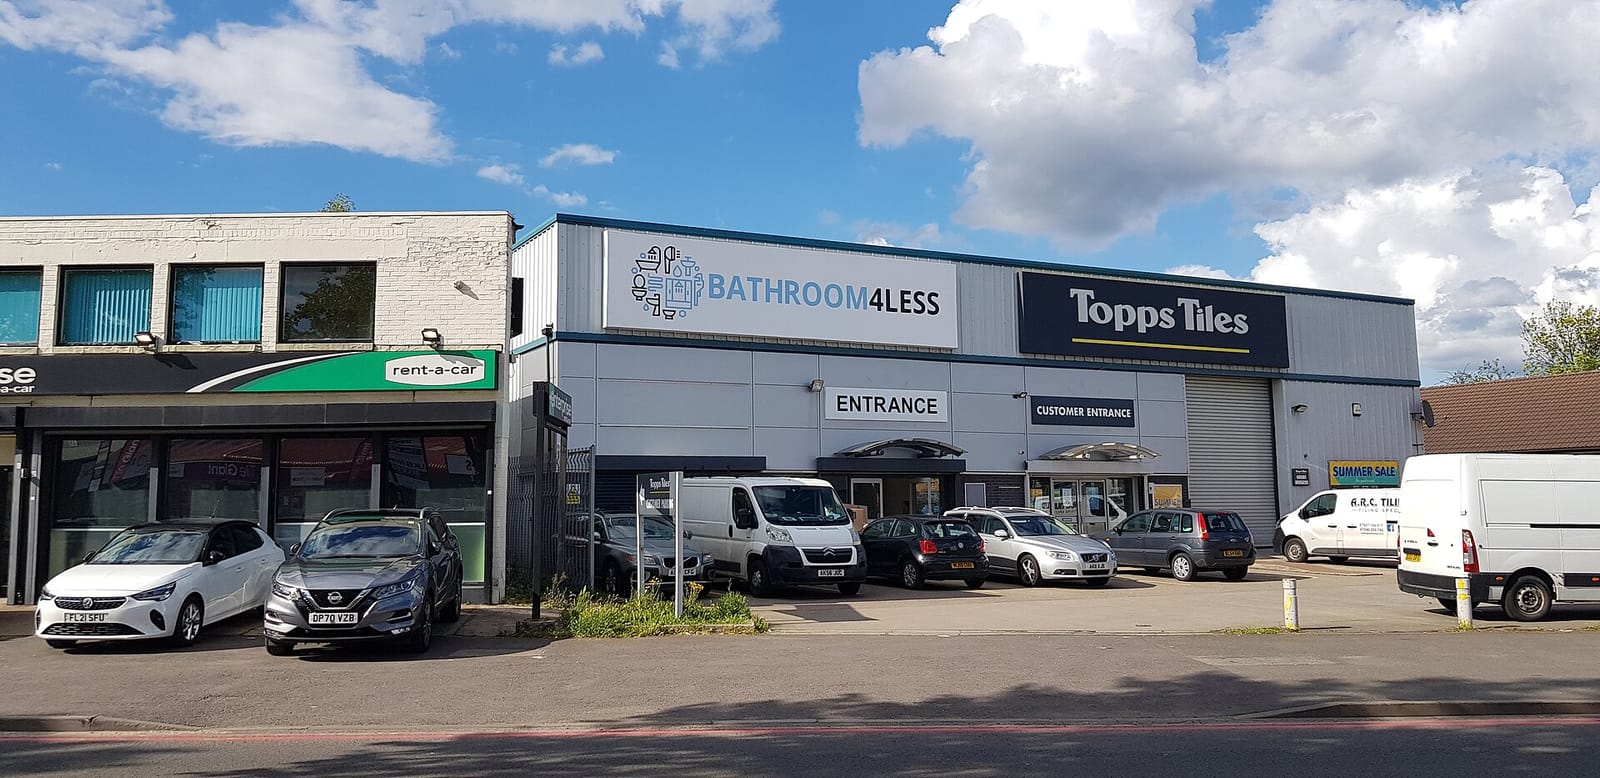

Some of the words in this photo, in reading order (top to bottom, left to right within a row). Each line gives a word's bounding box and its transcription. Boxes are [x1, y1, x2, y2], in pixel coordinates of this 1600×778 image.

[708, 273, 940, 316] BATHROOM4LESS
[1069, 288, 1176, 334] Topps
[1177, 297, 1249, 335] Tiles
[393, 365, 477, 376] rent-a-car
[836, 395, 938, 414] ENTRANCE
[1036, 405, 1085, 417] CUSTOMER
[1086, 407, 1132, 418] ENTRANCE
[1333, 466, 1373, 477] SUMMER
[1374, 466, 1396, 477] SALE
[1350, 497, 1378, 507] A.R.C.
[1380, 498, 1400, 507] TILI
[88, 613, 105, 622] SFU
[312, 614, 336, 622] DP70
[337, 613, 355, 622] VZB
